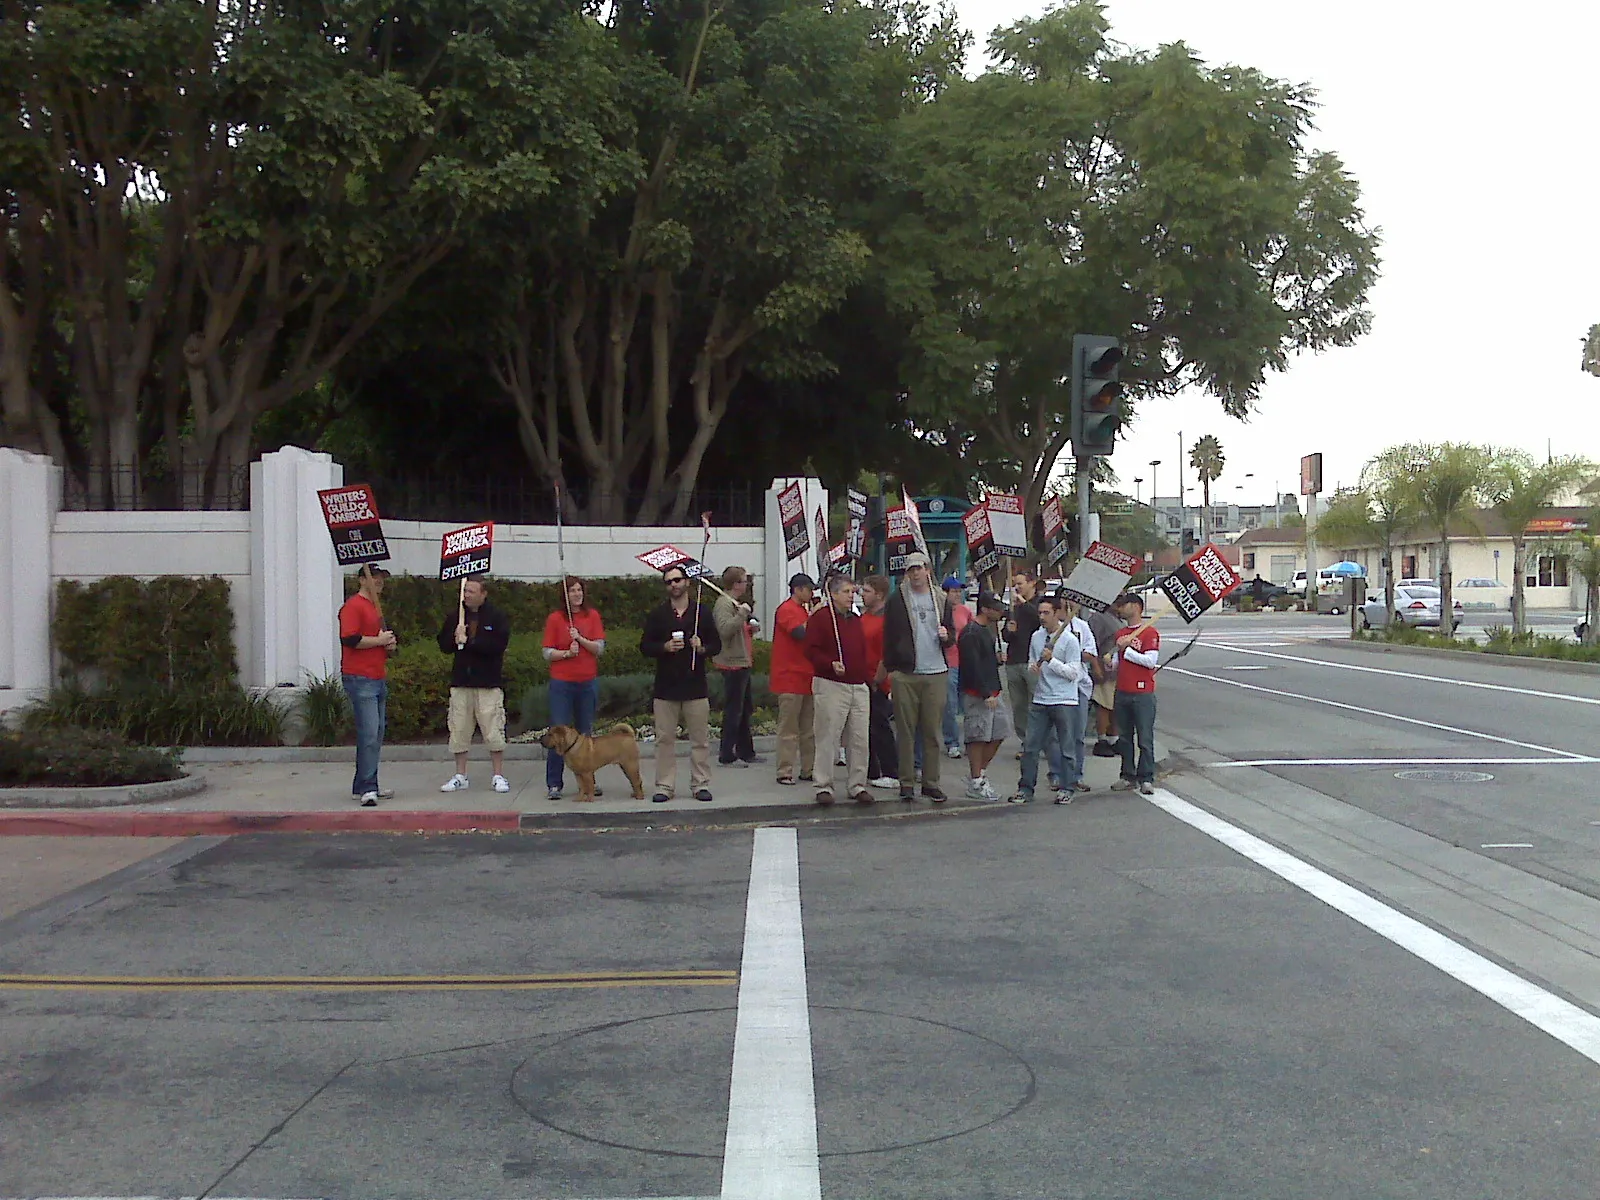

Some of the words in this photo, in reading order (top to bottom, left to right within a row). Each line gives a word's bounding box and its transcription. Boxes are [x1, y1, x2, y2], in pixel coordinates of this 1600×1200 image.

[322, 490, 367, 504] WRITERS
[327, 501, 358, 514] GUILD
[329, 509, 375, 524] AMERICA
[337, 539, 386, 559] STRIKE
[458, 553, 471, 564] ON
[441, 557, 489, 580] STRIKE
[1204, 547, 1236, 586] WRITERS
[1186, 581, 1200, 596] ON
[1189, 559, 1222, 599] AMERICA
[1061, 589, 1107, 612] STRIKE
[1163, 575, 1202, 619] STRIKE
